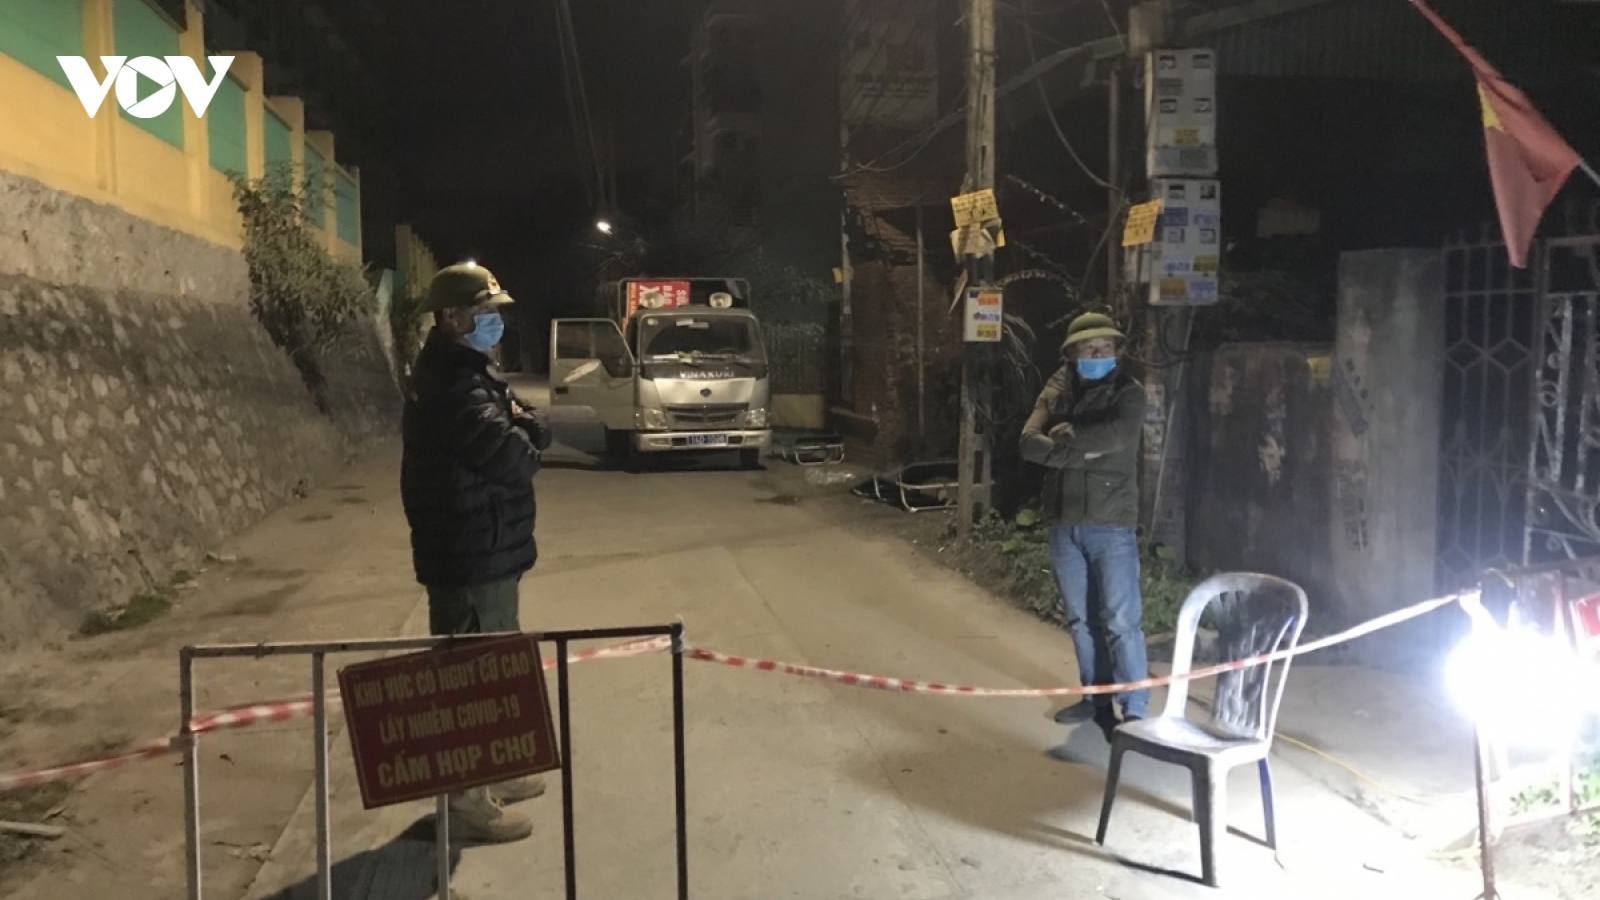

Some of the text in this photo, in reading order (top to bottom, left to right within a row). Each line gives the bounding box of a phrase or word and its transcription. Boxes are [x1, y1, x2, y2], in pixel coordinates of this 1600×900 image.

[354, 681, 384, 708] KHU
[384, 673, 414, 706] VỰC
[438, 660, 477, 691] NGUY
[502, 651, 530, 678] CAO
[457, 694, 520, 728] COVID-19
[377, 729, 537, 788] CẤM HỌP CHỢ
